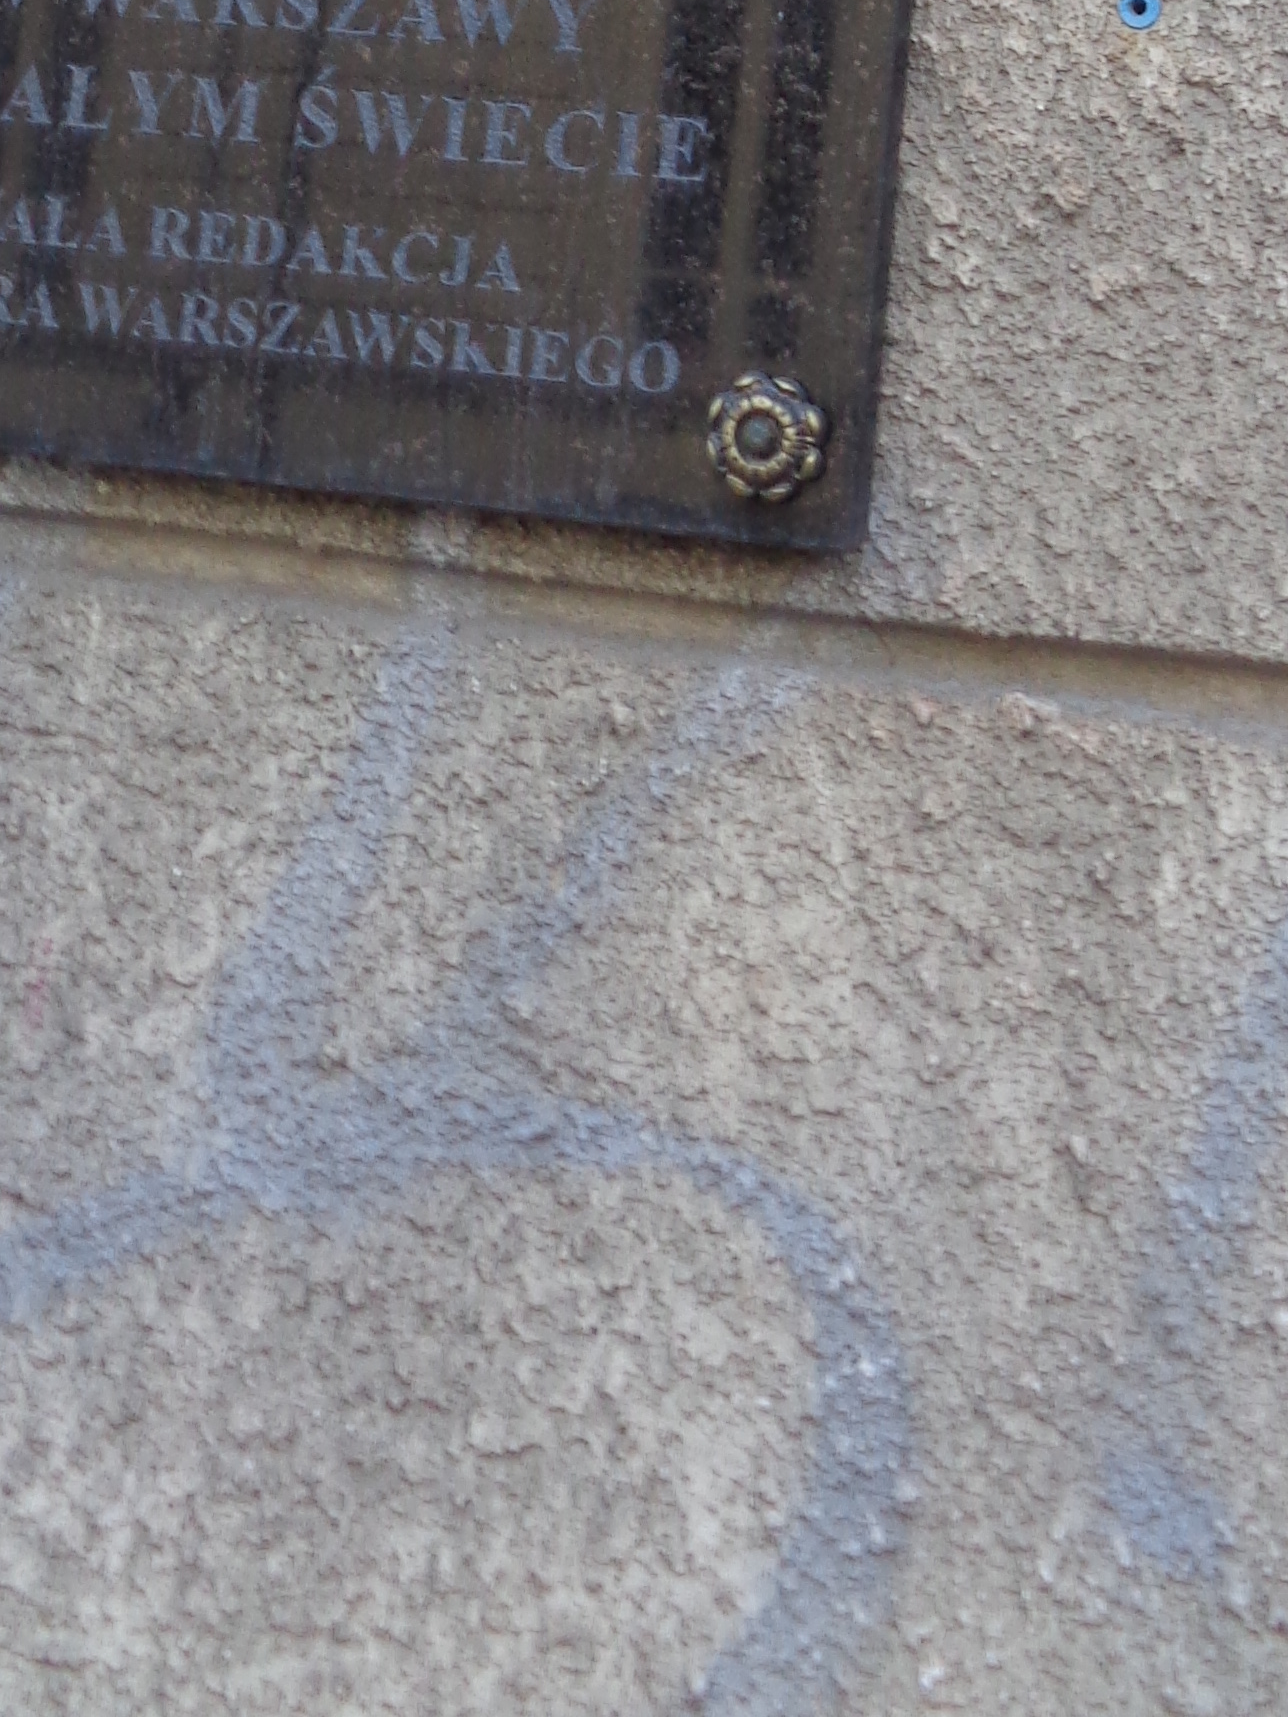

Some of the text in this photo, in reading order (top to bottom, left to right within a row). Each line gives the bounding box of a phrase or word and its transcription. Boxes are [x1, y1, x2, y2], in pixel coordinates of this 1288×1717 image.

[293, 66, 713, 185] ŚWIECIE
[147, 205, 526, 294] REDAKCJA
[77, 283, 683, 396] WARSZAWSKIEGO
